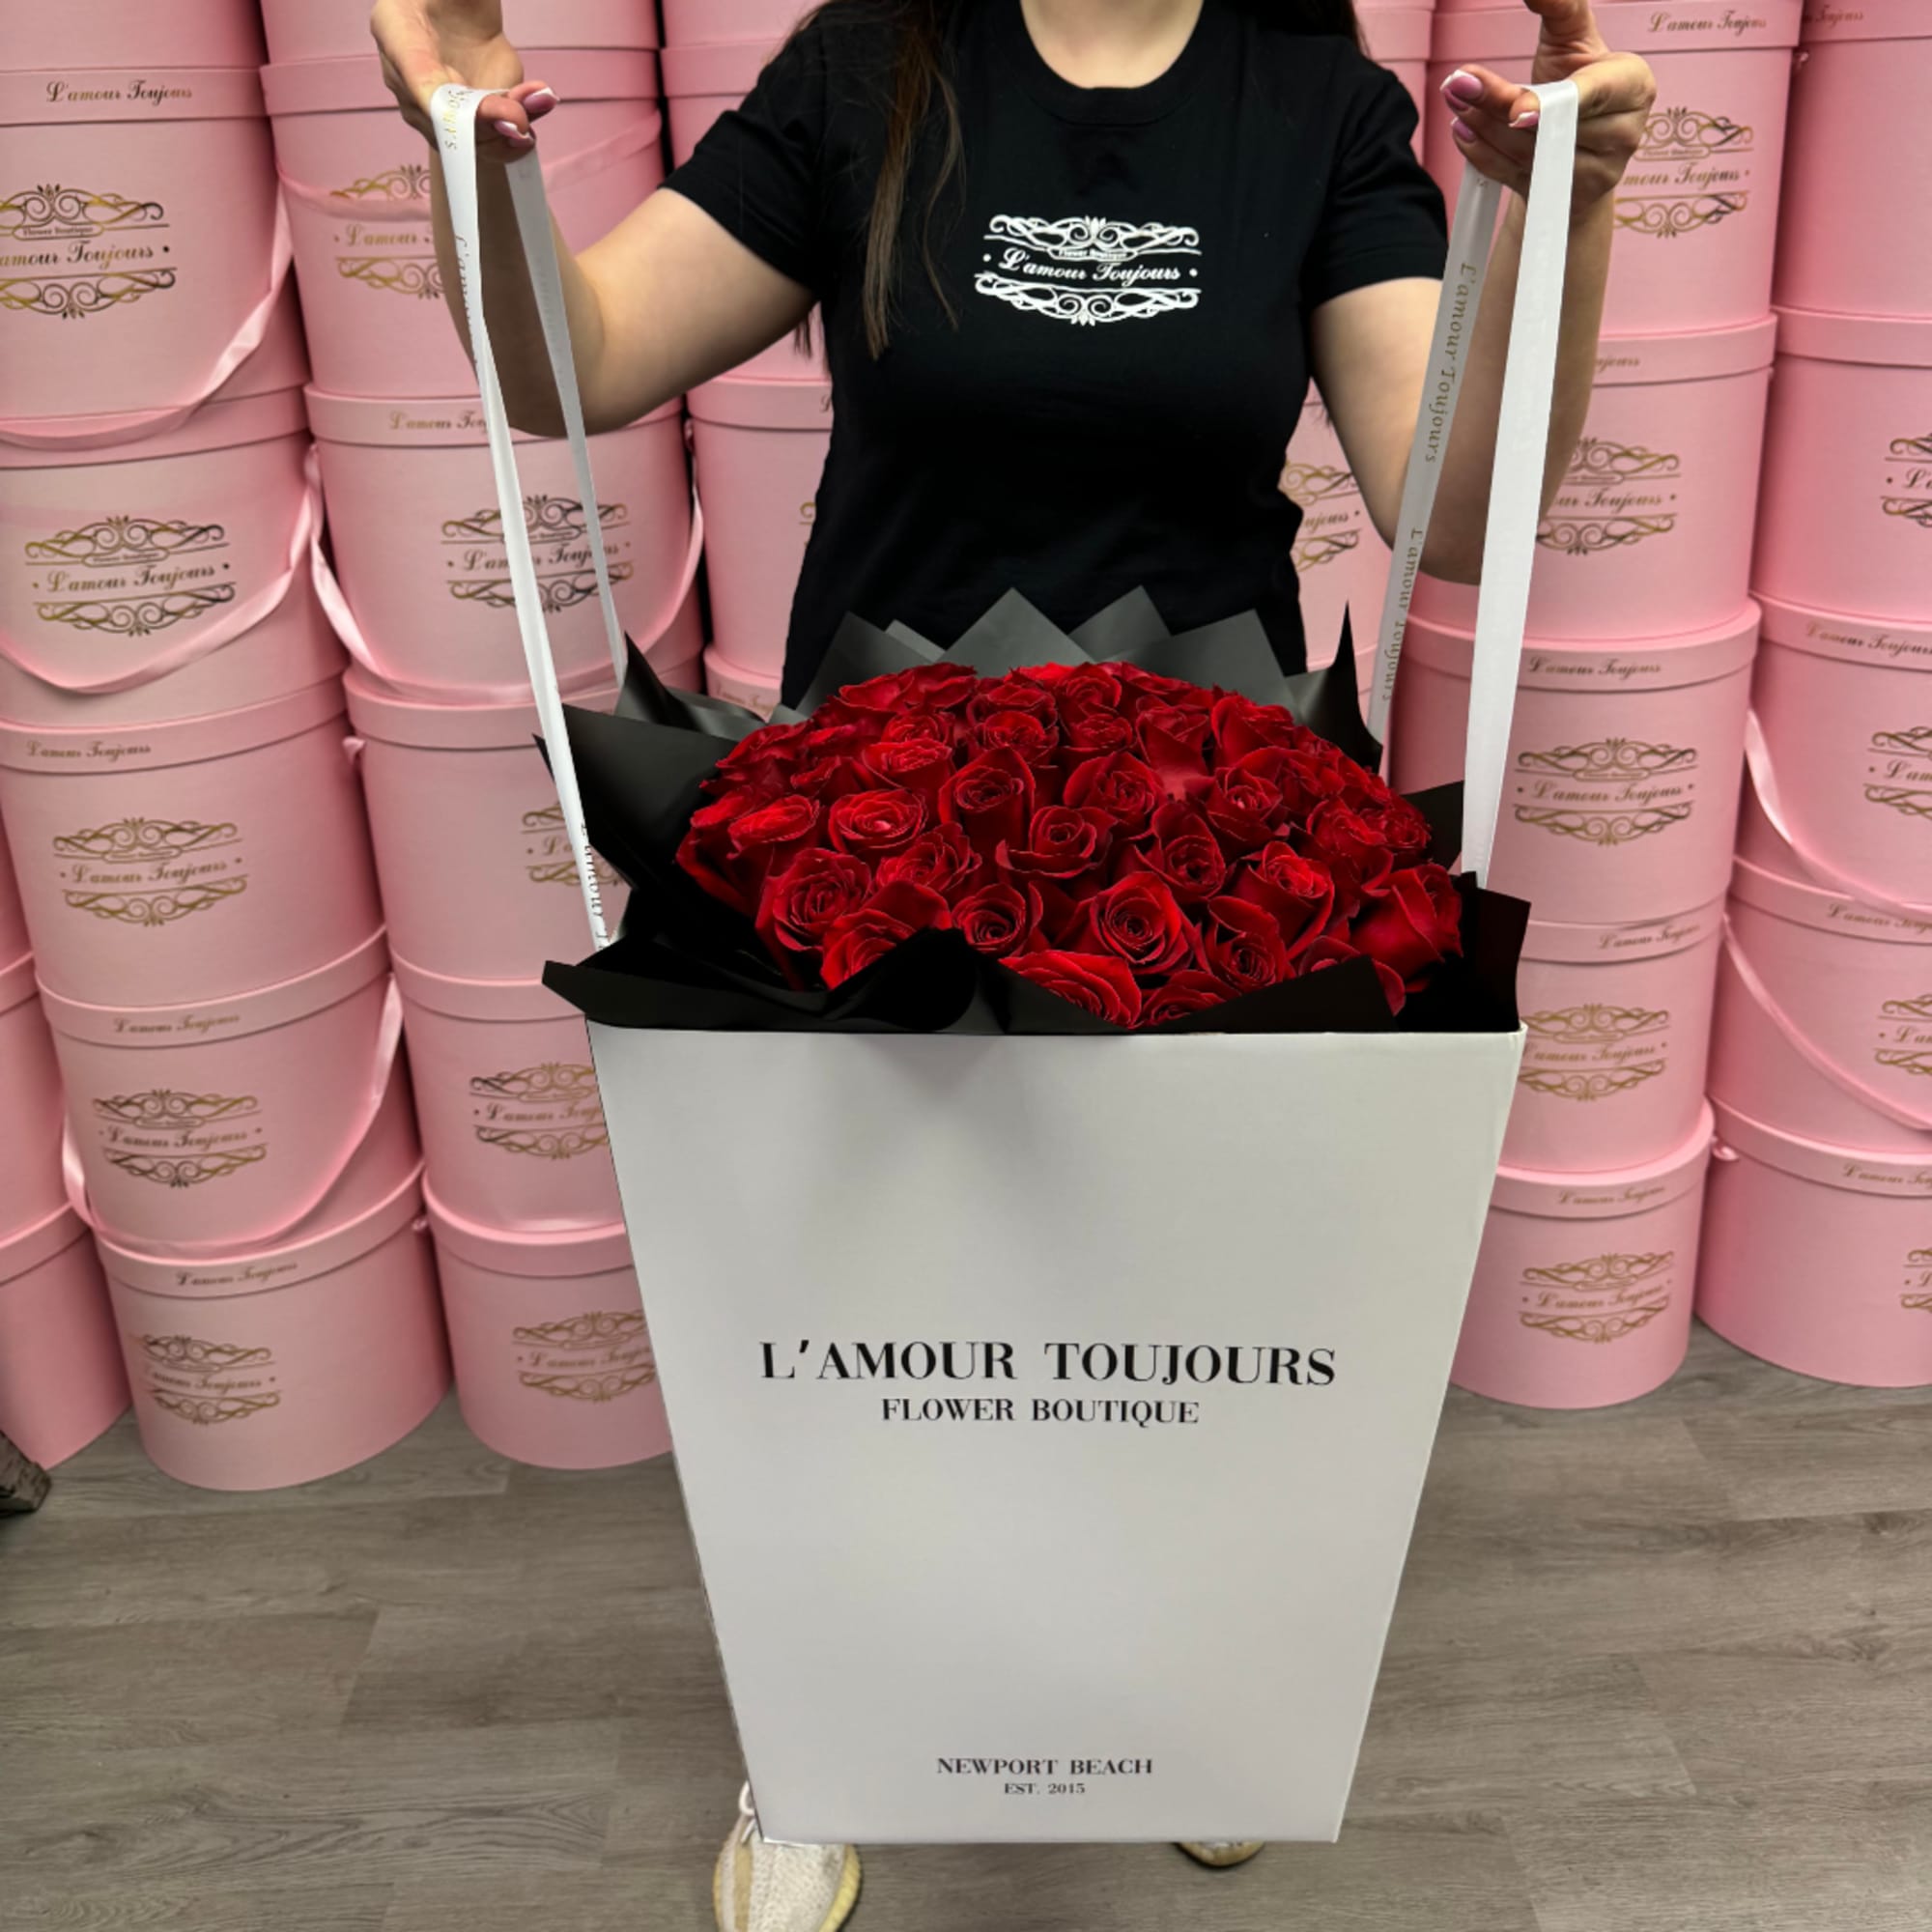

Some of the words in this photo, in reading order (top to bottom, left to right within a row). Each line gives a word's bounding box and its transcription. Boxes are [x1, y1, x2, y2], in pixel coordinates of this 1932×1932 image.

[1647, 12, 1713, 33] L'amour
[1718, 10, 1767, 36] Toujours
[46, 80, 121, 102] L'amour
[127, 79, 192, 106] Toujours
[1674, 161, 1741, 190] Toujours
[346, 223, 417, 246] L'amour
[67, 240, 154, 270] Toujours
[999, 247, 1087, 280] L'amour
[1092, 263, 1181, 286] Toujours
[1444, 262, 1477, 361] L'amour
[1425, 368, 1456, 464] Toujours
[1583, 486, 1662, 515] Toujours
[46, 570, 127, 593] L'amour
[133, 564, 215, 591] Toujours
[1528, 656, 1593, 674] L'amour
[1598, 659, 1662, 680] Toujours
[1532, 780, 1608, 802] L'amour
[1615, 782, 1683, 806] Toujours
[71, 864, 142, 884] L'amour
[148, 861, 227, 884] Toujours
[758, 1339, 1017, 1381] L'AMOUR
[1043, 1341, 1336, 1387] TOUJOURS
[881, 1397, 1015, 1422] FLOWER
[1031, 1398, 1200, 1429] BOUTIQUE
[936, 1756, 1059, 1776] NEWPORT
[1069, 1758, 1153, 1776] BEACH
[1004, 1781, 1041, 1795] EST.
[1047, 1782, 1086, 1795] 2015
